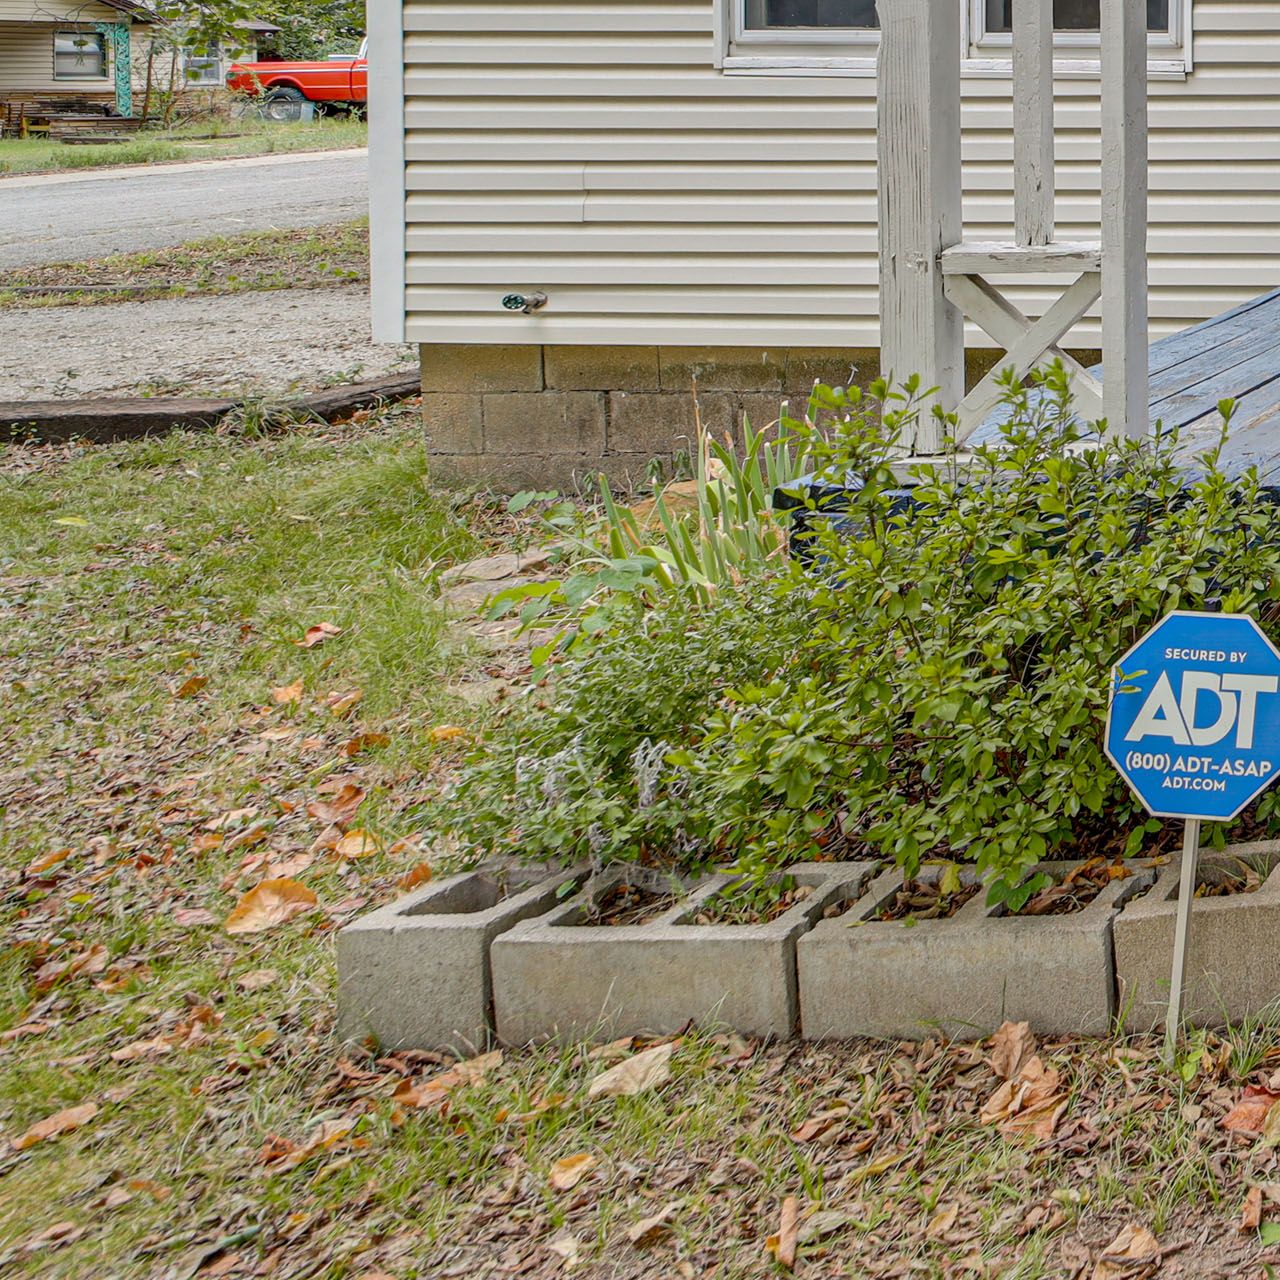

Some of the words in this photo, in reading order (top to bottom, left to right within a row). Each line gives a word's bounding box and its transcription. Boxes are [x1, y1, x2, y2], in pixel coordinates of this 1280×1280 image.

[1164, 647, 1226, 662] SECURED
[1230, 651, 1248, 663] BY
[1123, 669, 1280, 750] ADT
[1125, 750, 1171, 774] (800)
[1172, 756, 1272, 777] ADT-ASAP
[1161, 775, 1227, 792] ADT.COM
